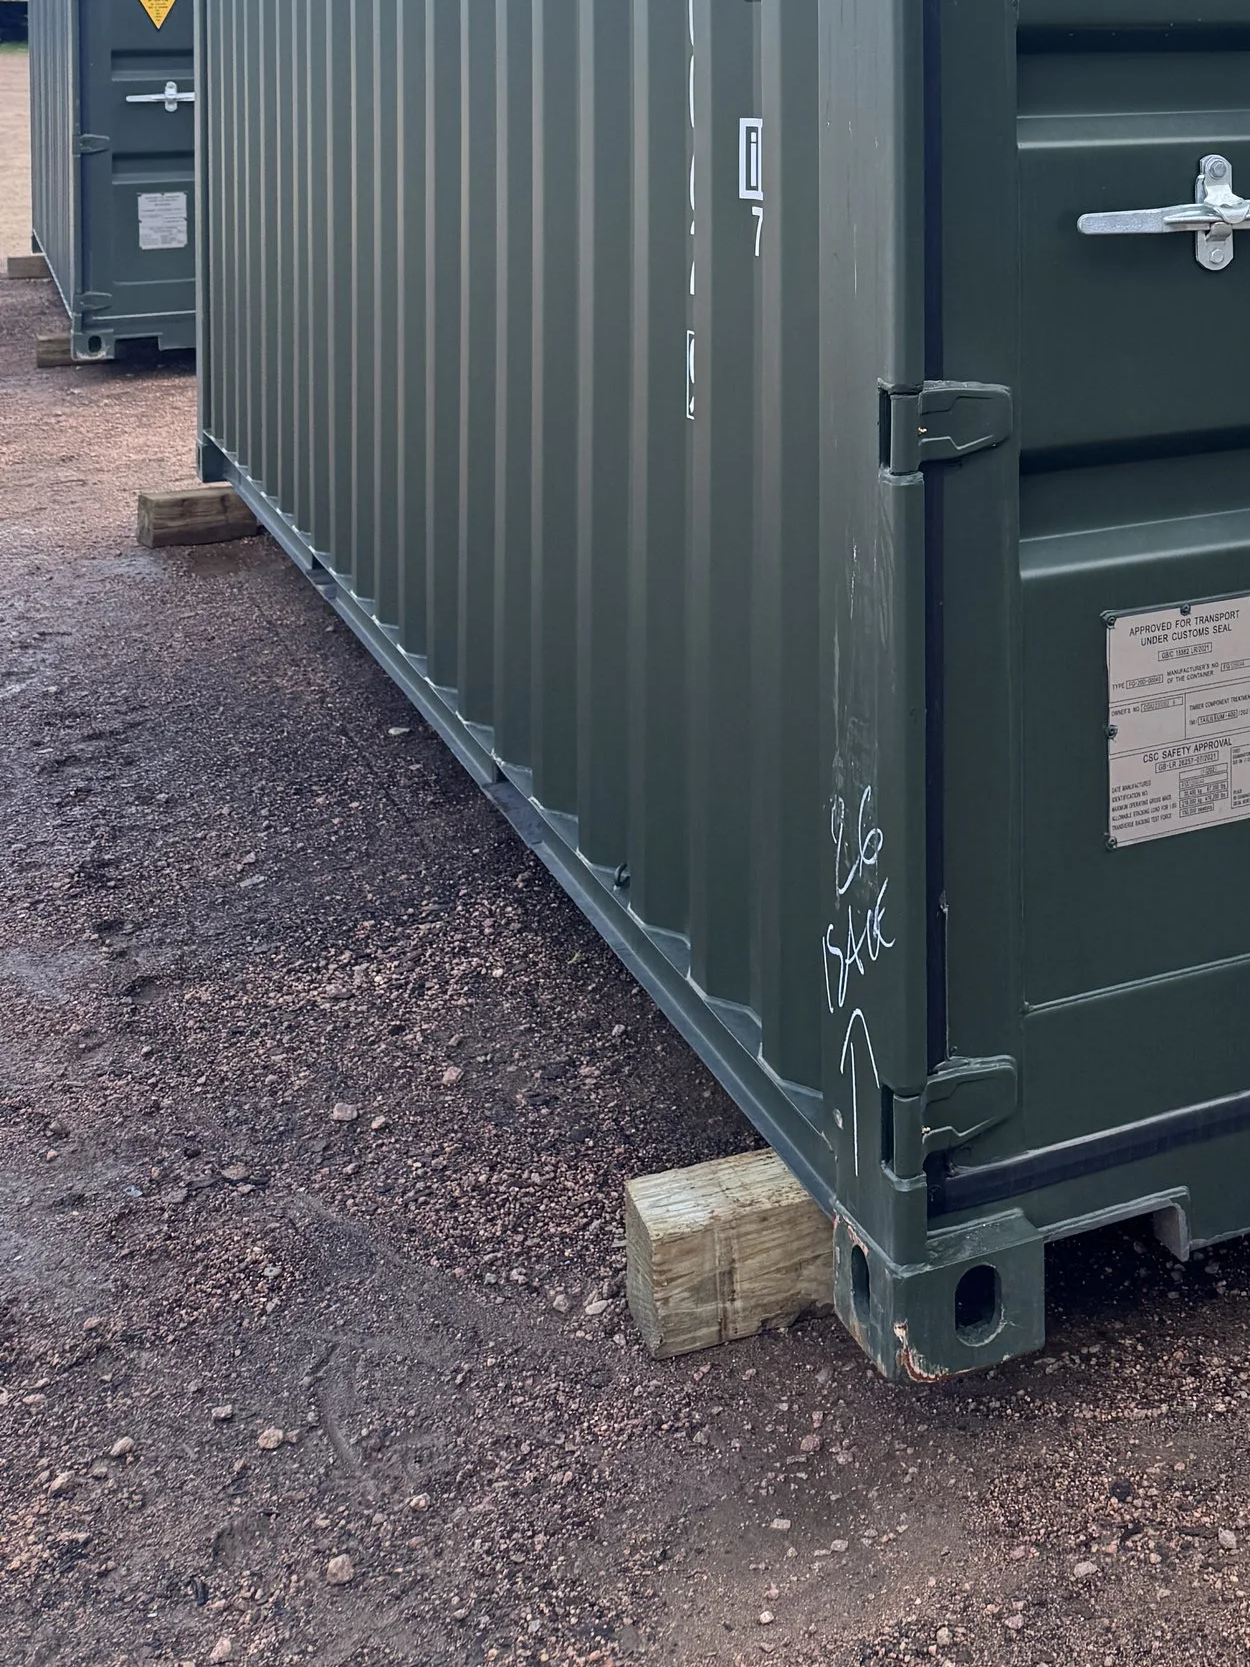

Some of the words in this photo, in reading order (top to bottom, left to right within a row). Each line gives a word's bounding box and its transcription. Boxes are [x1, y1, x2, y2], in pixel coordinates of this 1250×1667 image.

[1129, 621, 1172, 637] APPROVED
[1175, 617, 1192, 629] FOR
[1195, 609, 1241, 625] TRANSPORT
[1140, 634, 1169, 647] UNDER
[1171, 627, 1210, 642] CUSTOMS
[1212, 623, 1232, 634] SEAL
[1175, 675, 1186, 683] THE
[1186, 670, 1214, 682] CONTAINER
[1143, 753, 1160, 764] CSC
[1161, 745, 1191, 760] SAFETY
[1193, 737, 1233, 754] APPROVAL
